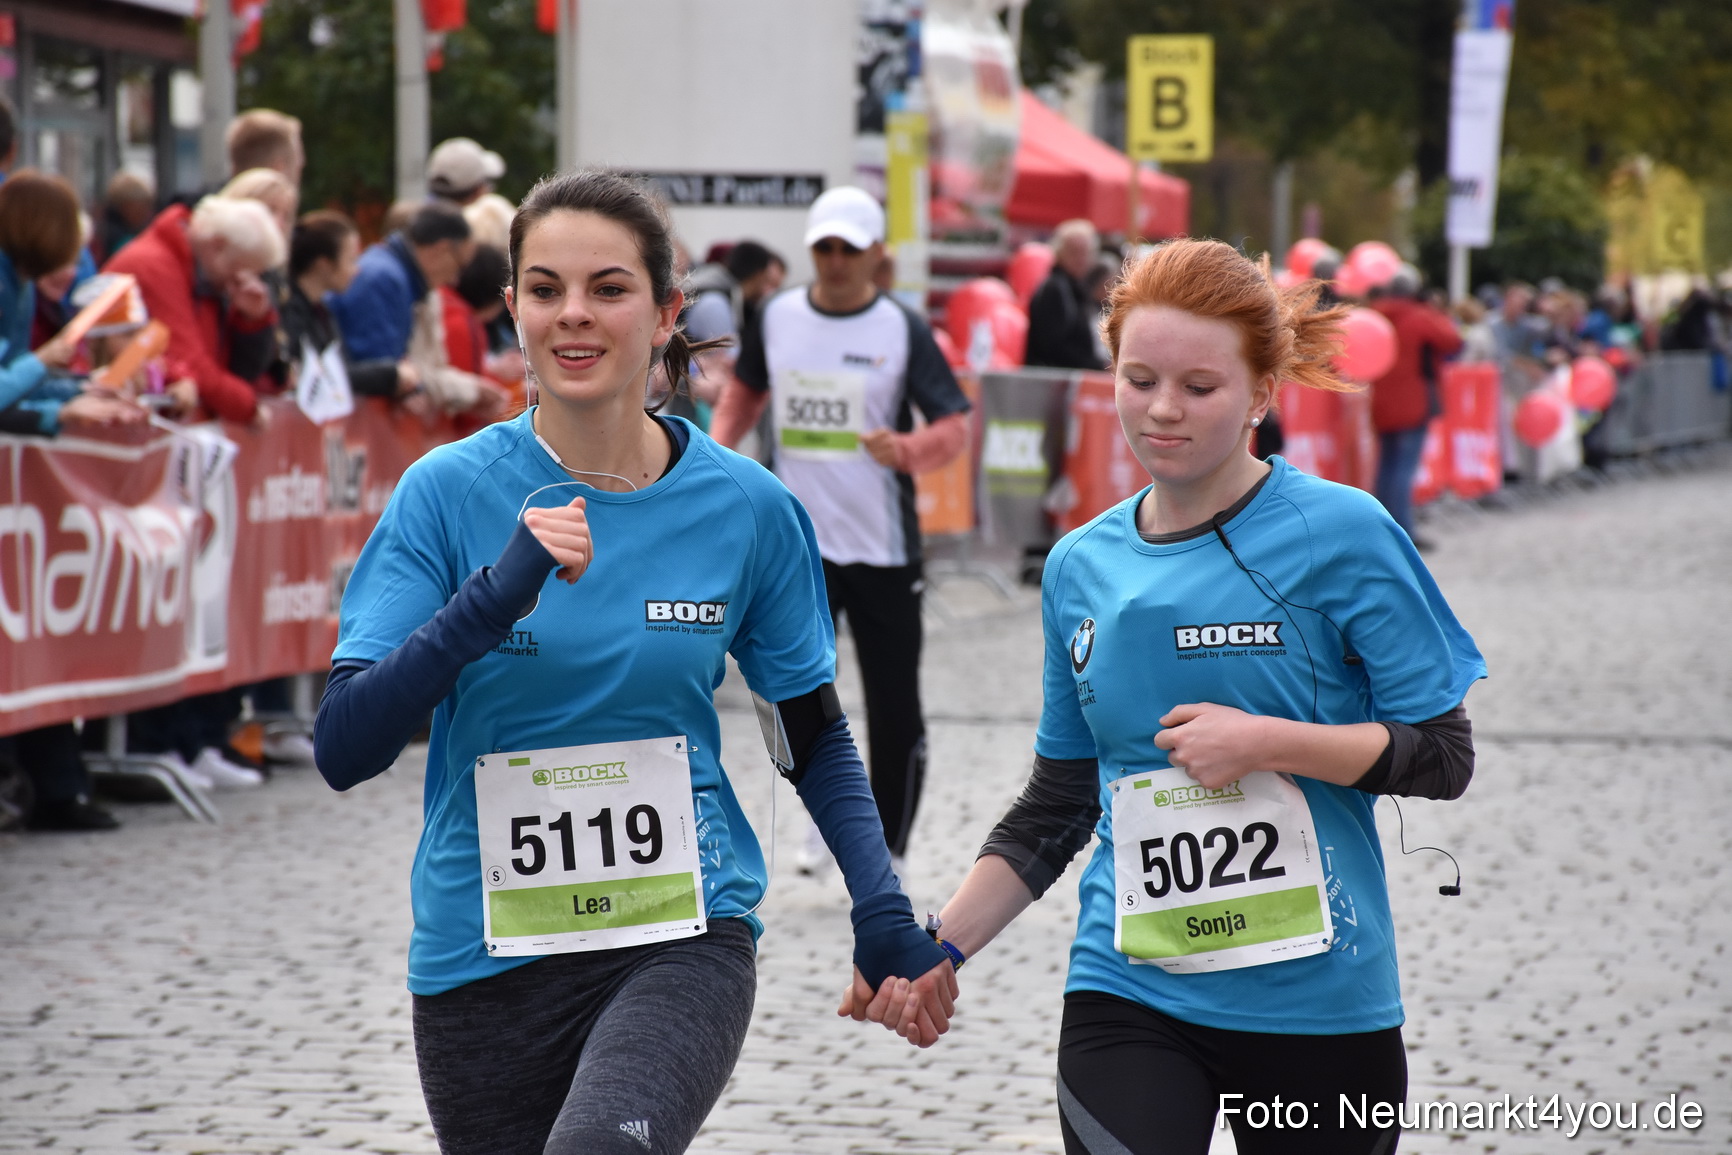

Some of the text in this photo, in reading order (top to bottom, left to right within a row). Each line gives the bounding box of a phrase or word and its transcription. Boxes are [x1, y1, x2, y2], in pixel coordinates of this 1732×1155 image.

[1152, 75, 1189, 132] B
[786, 397, 849, 427] 5033
[645, 600, 728, 625] BOCK
[502, 631, 538, 645] RTL
[645, 624, 680, 634] inspired
[681, 626, 691, 635] by
[1174, 621, 1286, 651] BOCK
[1177, 648, 1287, 661] inspired by smart concepts
[1078, 680, 1094, 696] RTL
[553, 762, 628, 784] BOCK
[554, 783, 577, 791] inspired
[586, 780, 604, 788] smart
[604, 779, 630, 787] concepts
[1173, 803, 1194, 811] inspired
[1220, 797, 1246, 805] concepts
[511, 804, 663, 876] 5119
[697, 821, 711, 842] 2017
[1140, 821, 1286, 899] 5022
[492, 871, 501, 882] S
[1126, 895, 1135, 906] S
[1327, 878, 1343, 902] 2017
[573, 894, 612, 915] Lea
[1186, 910, 1247, 938] Sonja
[620, 1123, 652, 1150] adidas
